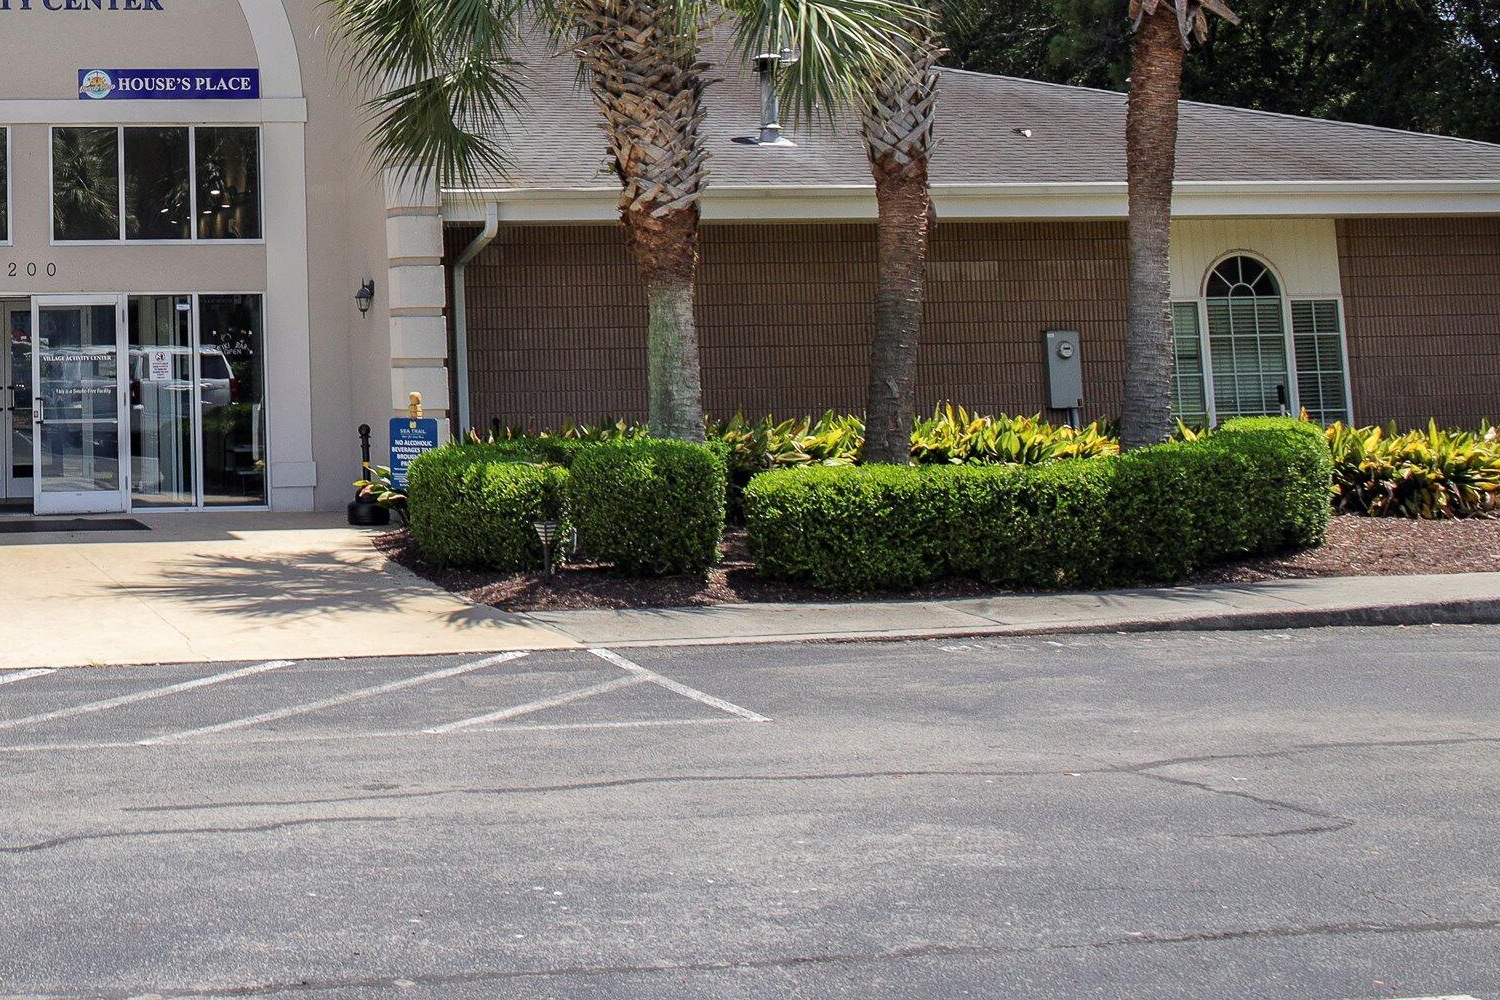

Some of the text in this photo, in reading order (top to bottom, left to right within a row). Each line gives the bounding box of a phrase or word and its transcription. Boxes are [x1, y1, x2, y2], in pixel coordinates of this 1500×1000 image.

[118, 77, 191, 91] HOUSE'S
[195, 78, 251, 91] PLACE
[8, 262, 56, 276] 200
